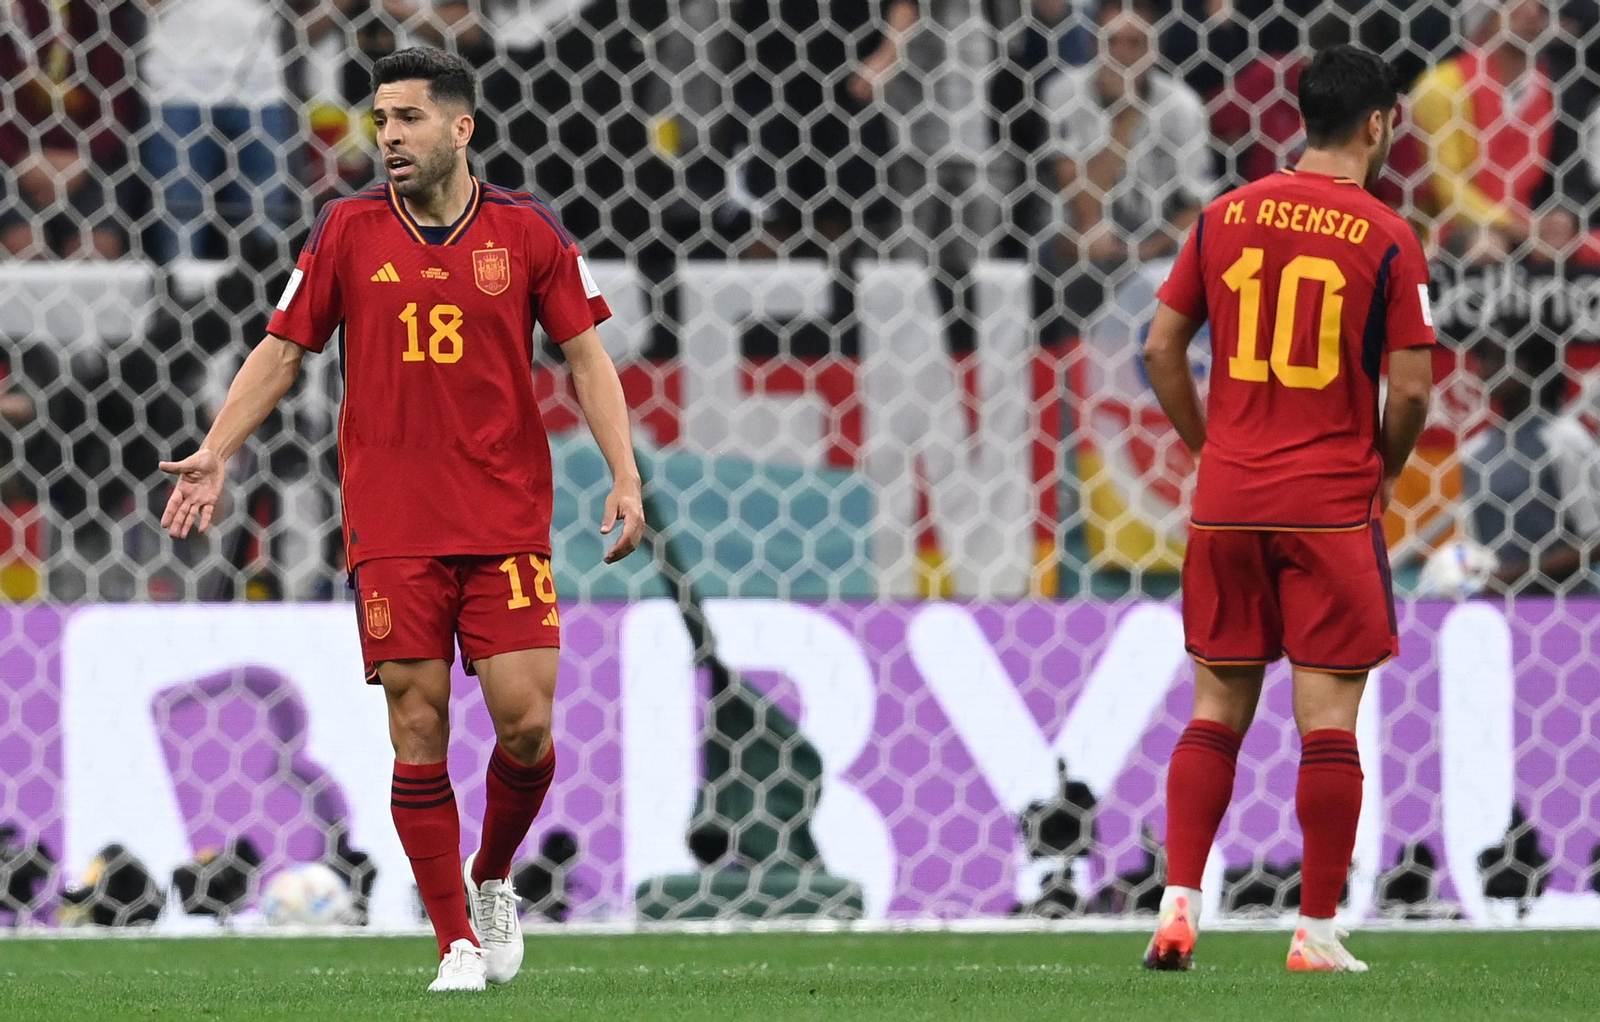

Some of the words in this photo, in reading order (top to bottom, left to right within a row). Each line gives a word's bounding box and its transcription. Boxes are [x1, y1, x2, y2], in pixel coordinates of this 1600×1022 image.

[1223, 199, 1247, 225] M.
[1256, 198, 1370, 244] ASENSIO
[398, 302, 463, 363] 18
[1221, 247, 1347, 390] 10
[498, 553, 556, 610] 18
